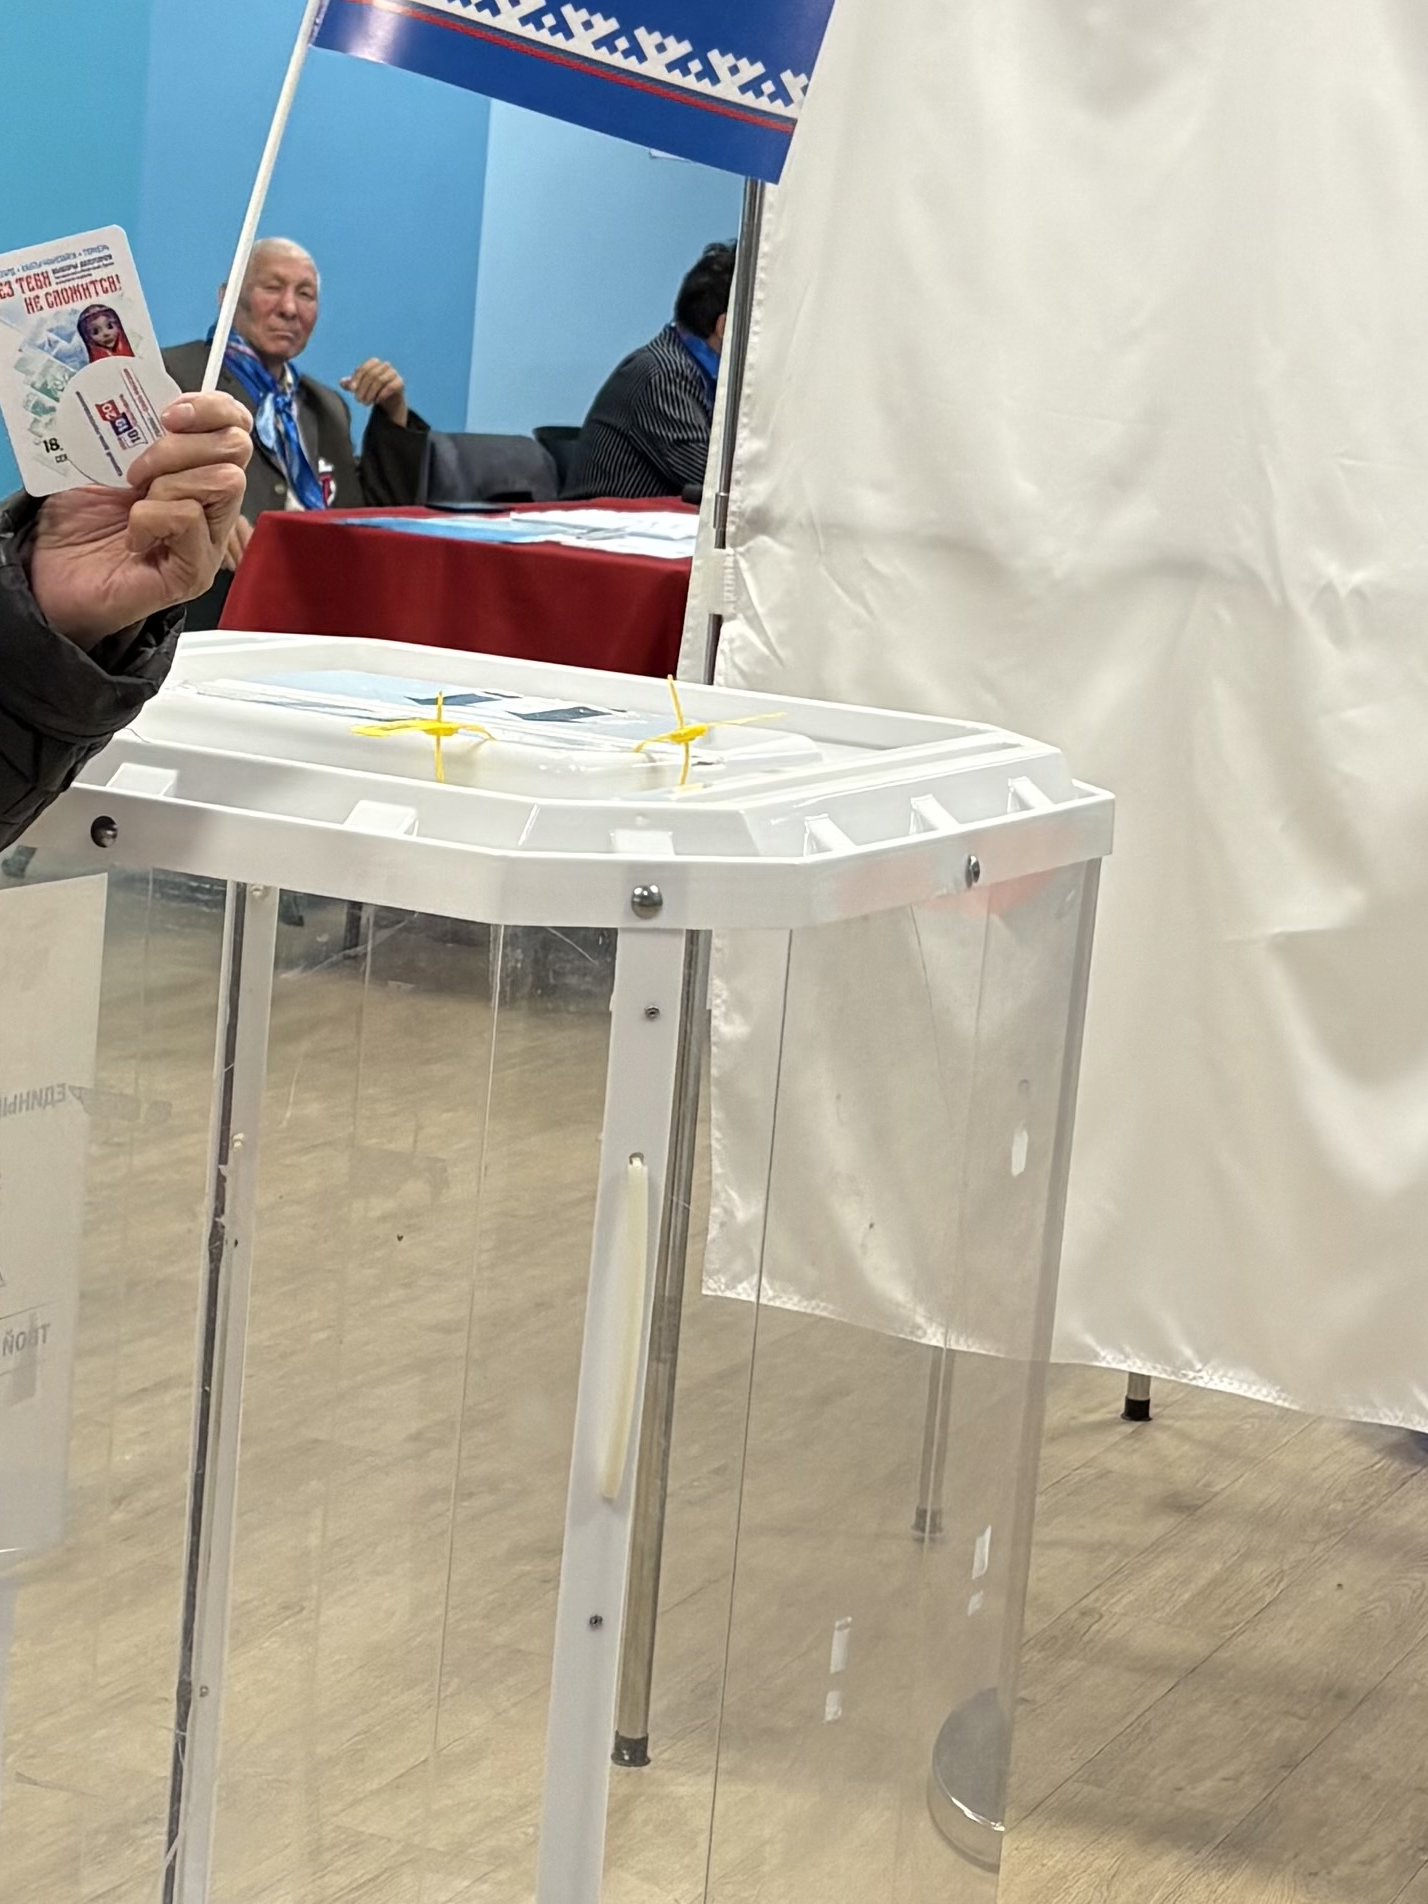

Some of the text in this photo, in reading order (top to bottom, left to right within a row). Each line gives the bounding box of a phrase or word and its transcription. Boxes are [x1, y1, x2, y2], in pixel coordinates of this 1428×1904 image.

[15, 271, 52, 295] ТЕБЯ
[24, 294, 44, 315] НЕ
[45, 274, 123, 309] СЛОЖИТСЯ!
